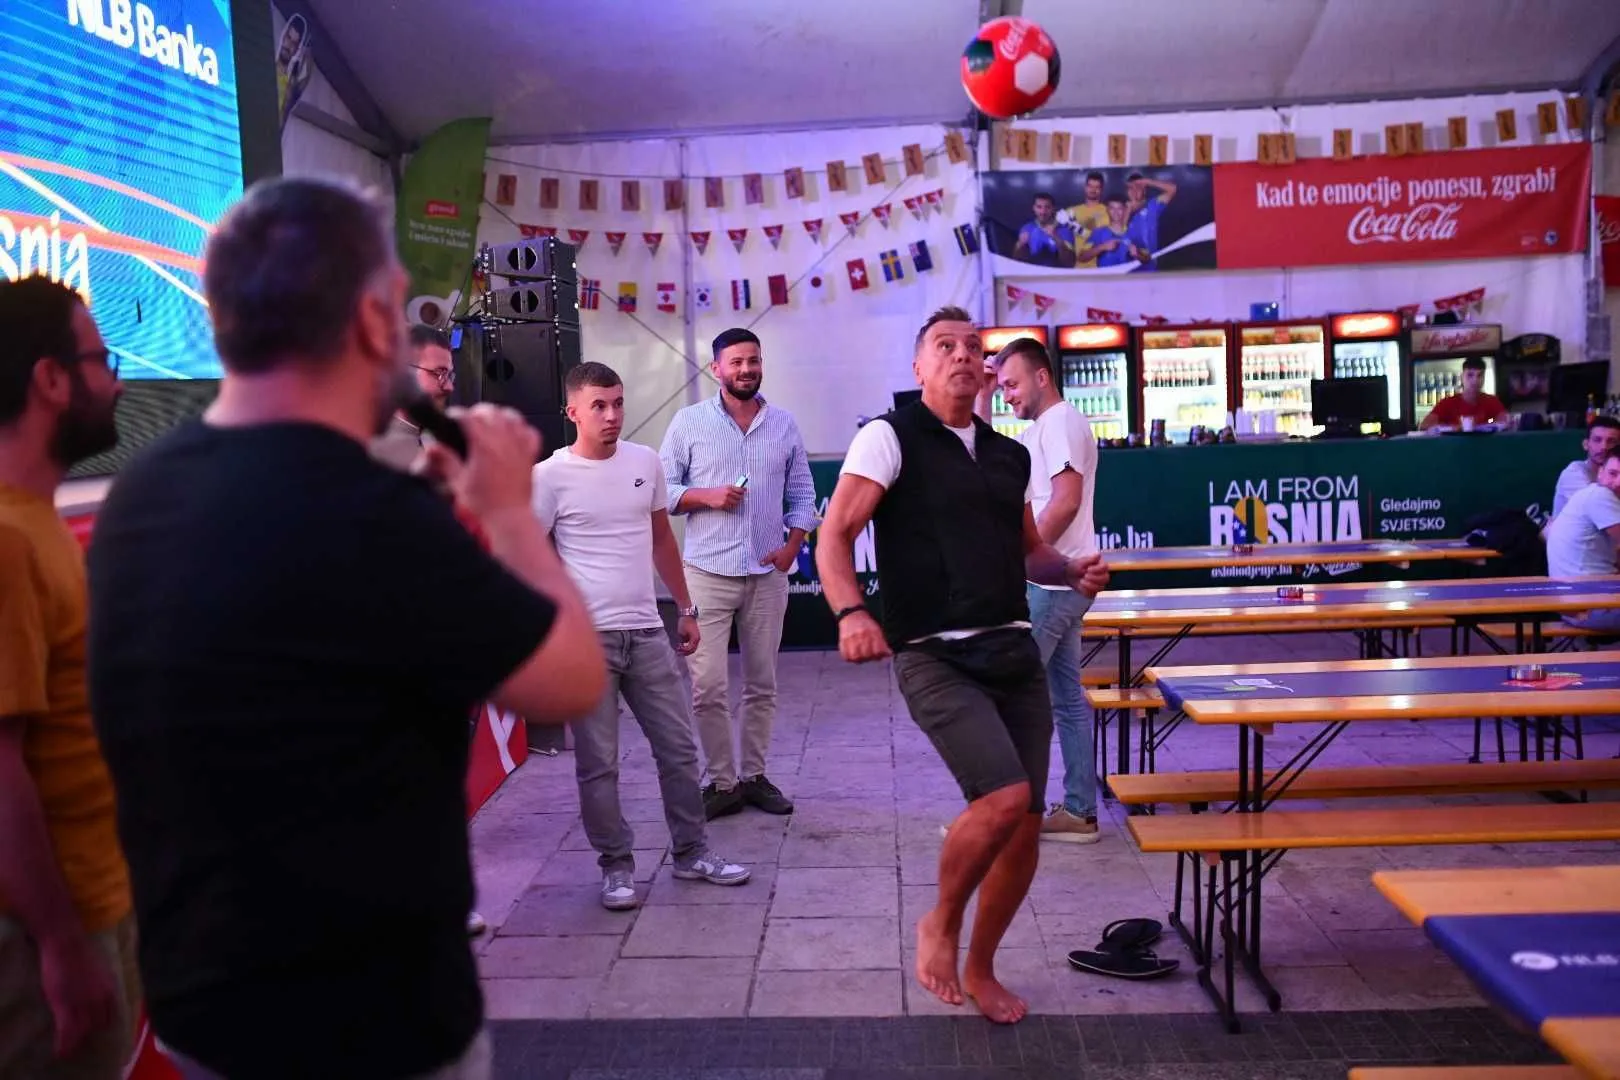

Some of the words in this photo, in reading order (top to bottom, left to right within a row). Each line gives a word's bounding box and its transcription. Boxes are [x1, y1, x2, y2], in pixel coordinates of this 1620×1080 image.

[67, 0, 136, 49] NLB
[136, 2, 220, 86] Banka
[1256, 181, 1294, 208] Kad
[1297, 182, 1319, 206] te
[1322, 177, 1402, 209] emocije
[1408, 174, 1488, 206] ponesu,
[1492, 166, 1557, 201] zgrabi
[1347, 202, 1464, 246] Coca-Cola
[1208, 480, 1214, 504] I
[1223, 478, 1268, 503] AM
[1277, 474, 1360, 501] FROM
[1380, 496, 1442, 515] Gledajmo
[1209, 498, 1363, 547] BOSNIA
[1380, 516, 1446, 533] SVJETSKO
